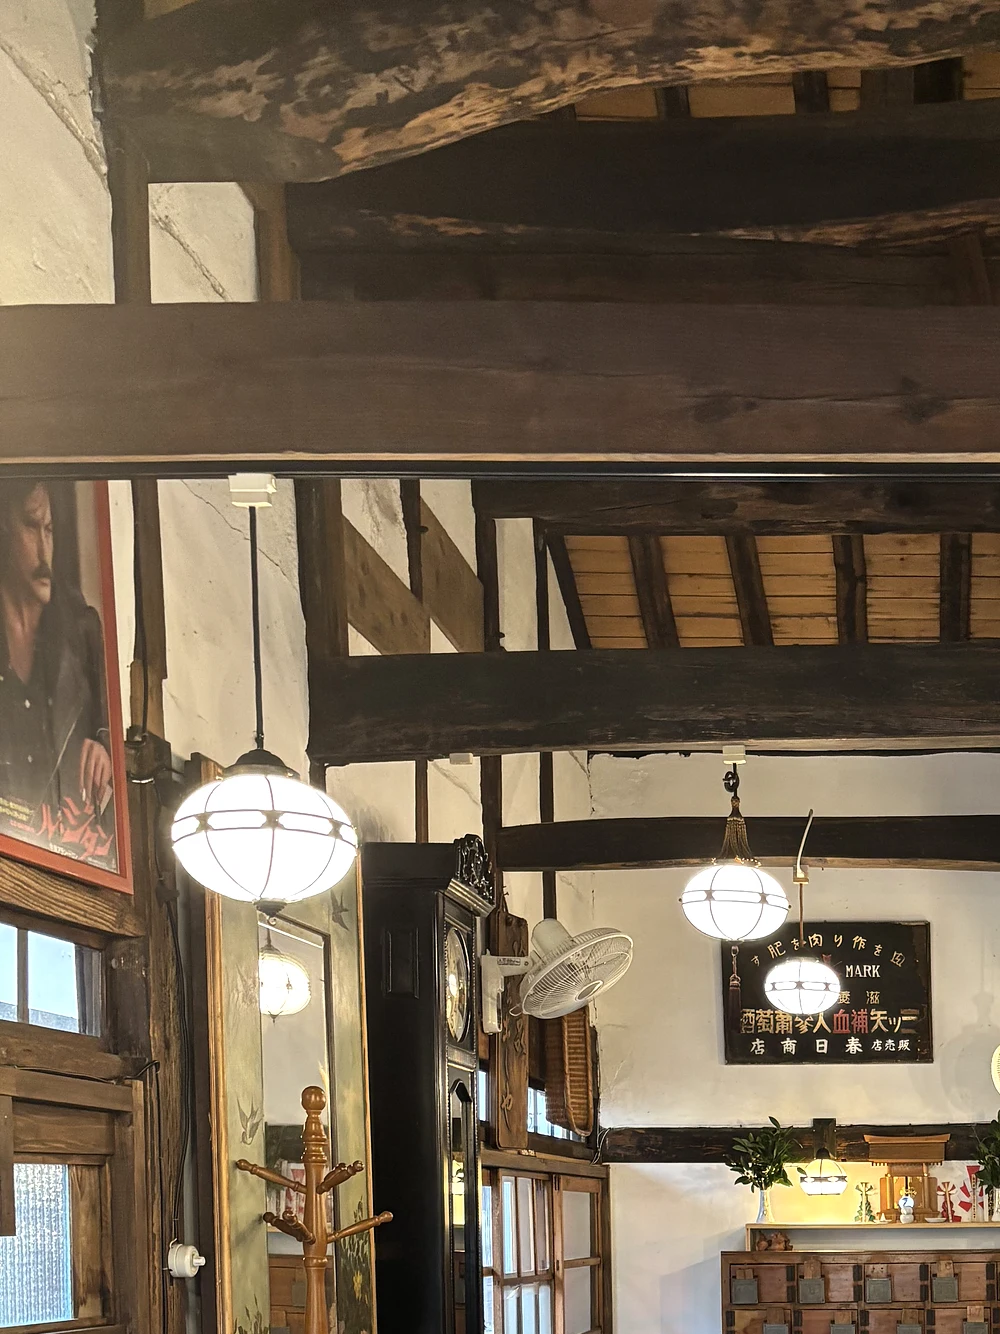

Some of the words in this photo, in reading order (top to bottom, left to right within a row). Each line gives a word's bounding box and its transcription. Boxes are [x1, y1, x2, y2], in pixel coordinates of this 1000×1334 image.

[845, 964, 881, 978] MARK
[750, 1036, 863, 1055] 春日商店
[871, 1039, 911, 1051] 販売店
